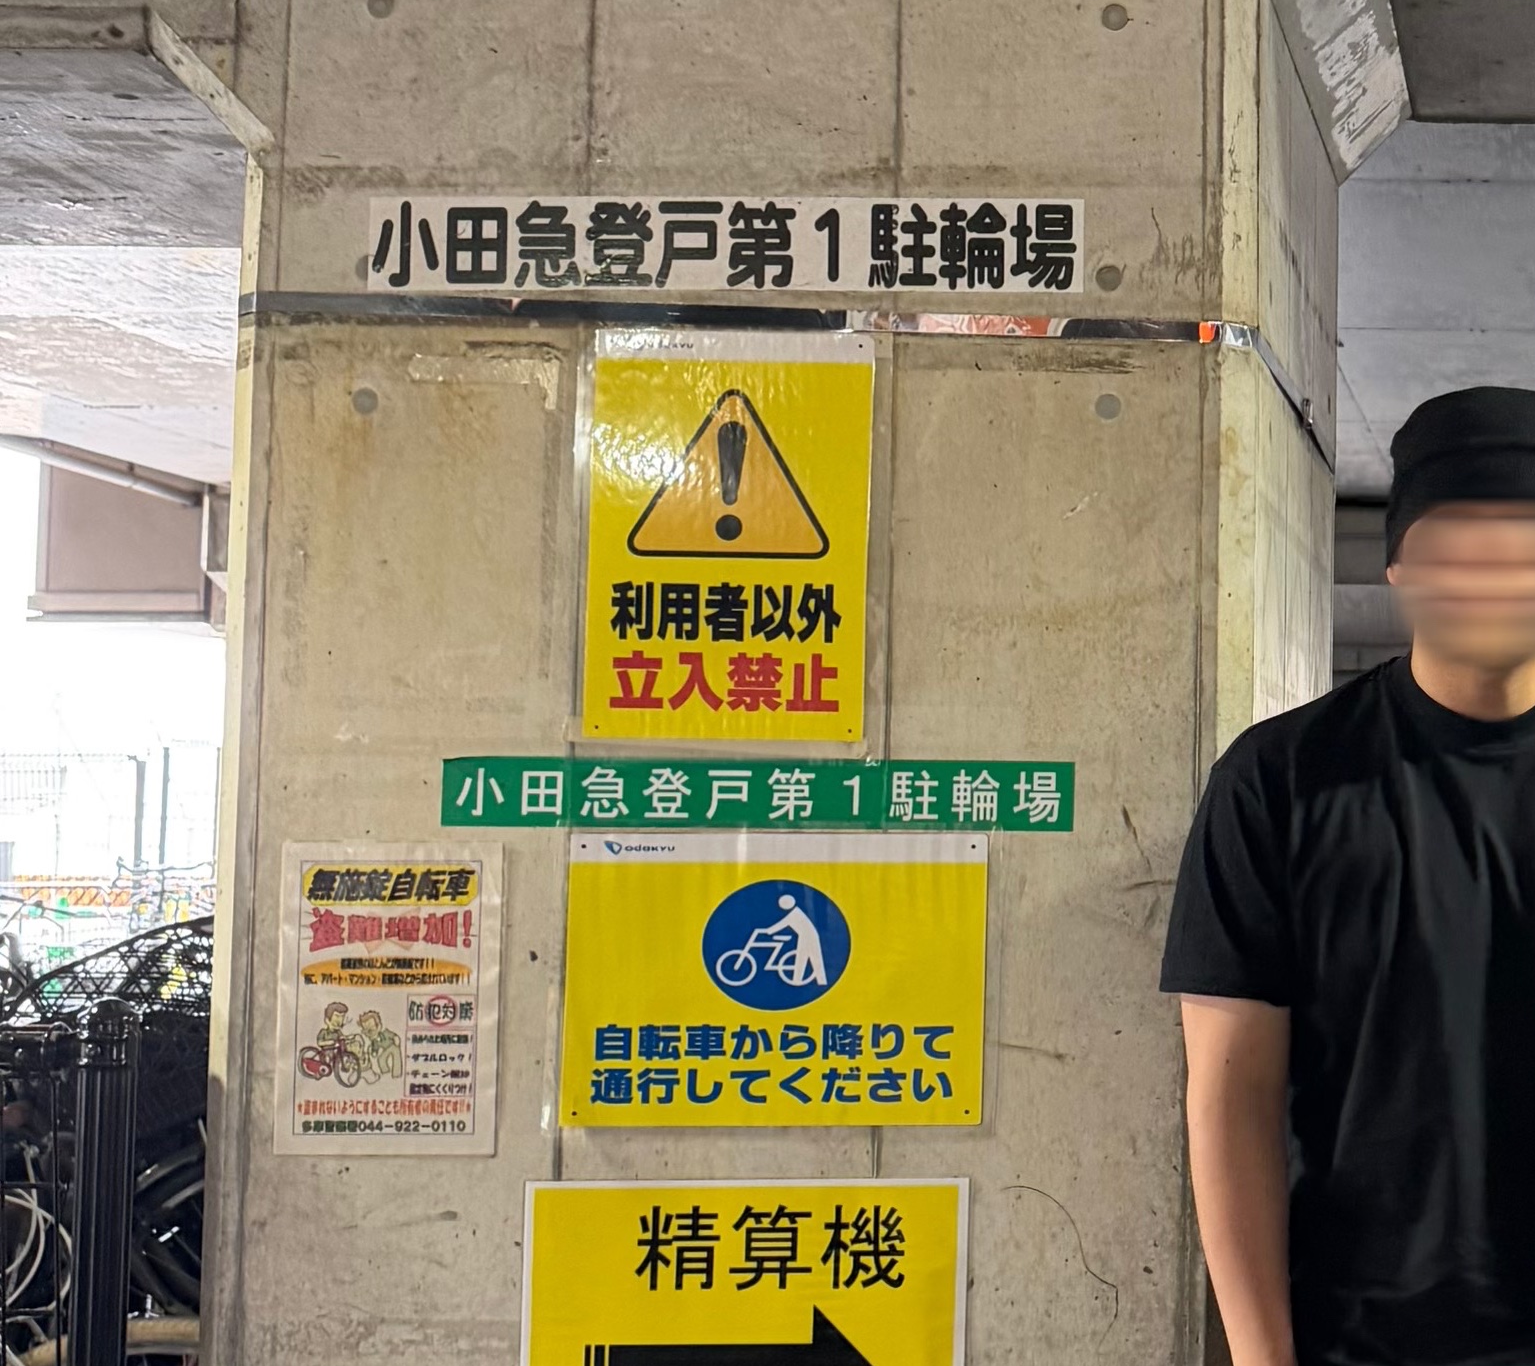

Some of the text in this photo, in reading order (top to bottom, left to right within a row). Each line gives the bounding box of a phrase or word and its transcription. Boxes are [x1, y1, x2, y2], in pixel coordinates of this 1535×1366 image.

[373, 200, 1077, 290] 小田急登戸第1駐輪場
[610, 582, 842, 642] 利用者以外
[610, 652, 840, 712] 立入禁止
[455, 766, 1063, 824] 小田急登戸第1駐輪場
[306, 867, 476, 902] 無施錠自転車
[594, 1024, 954, 1062] 自転車から降りて
[590, 1068, 953, 1105] 通行してください
[635, 1203, 905, 1291] 精算機
